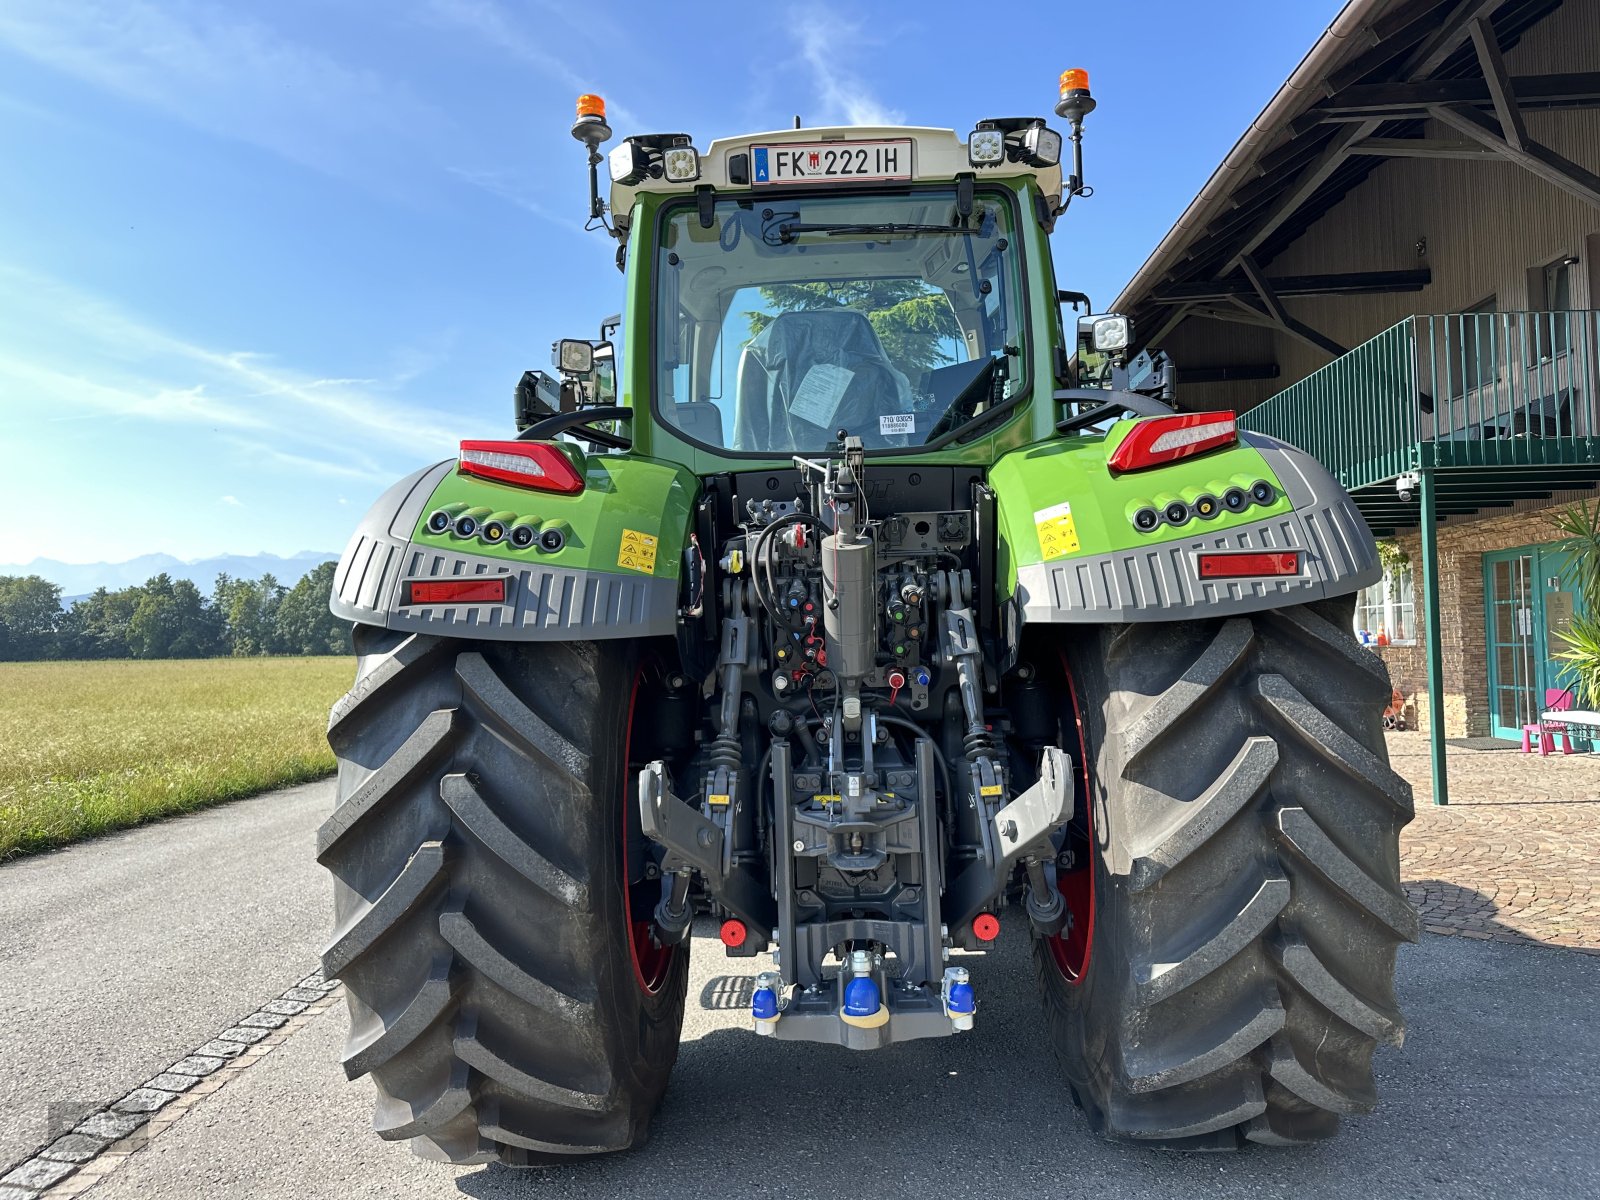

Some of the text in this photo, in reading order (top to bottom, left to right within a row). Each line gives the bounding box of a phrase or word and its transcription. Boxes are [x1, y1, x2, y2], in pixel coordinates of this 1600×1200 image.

[776, 147, 898, 177] FK 222 IH
[758, 169, 766, 177] A
